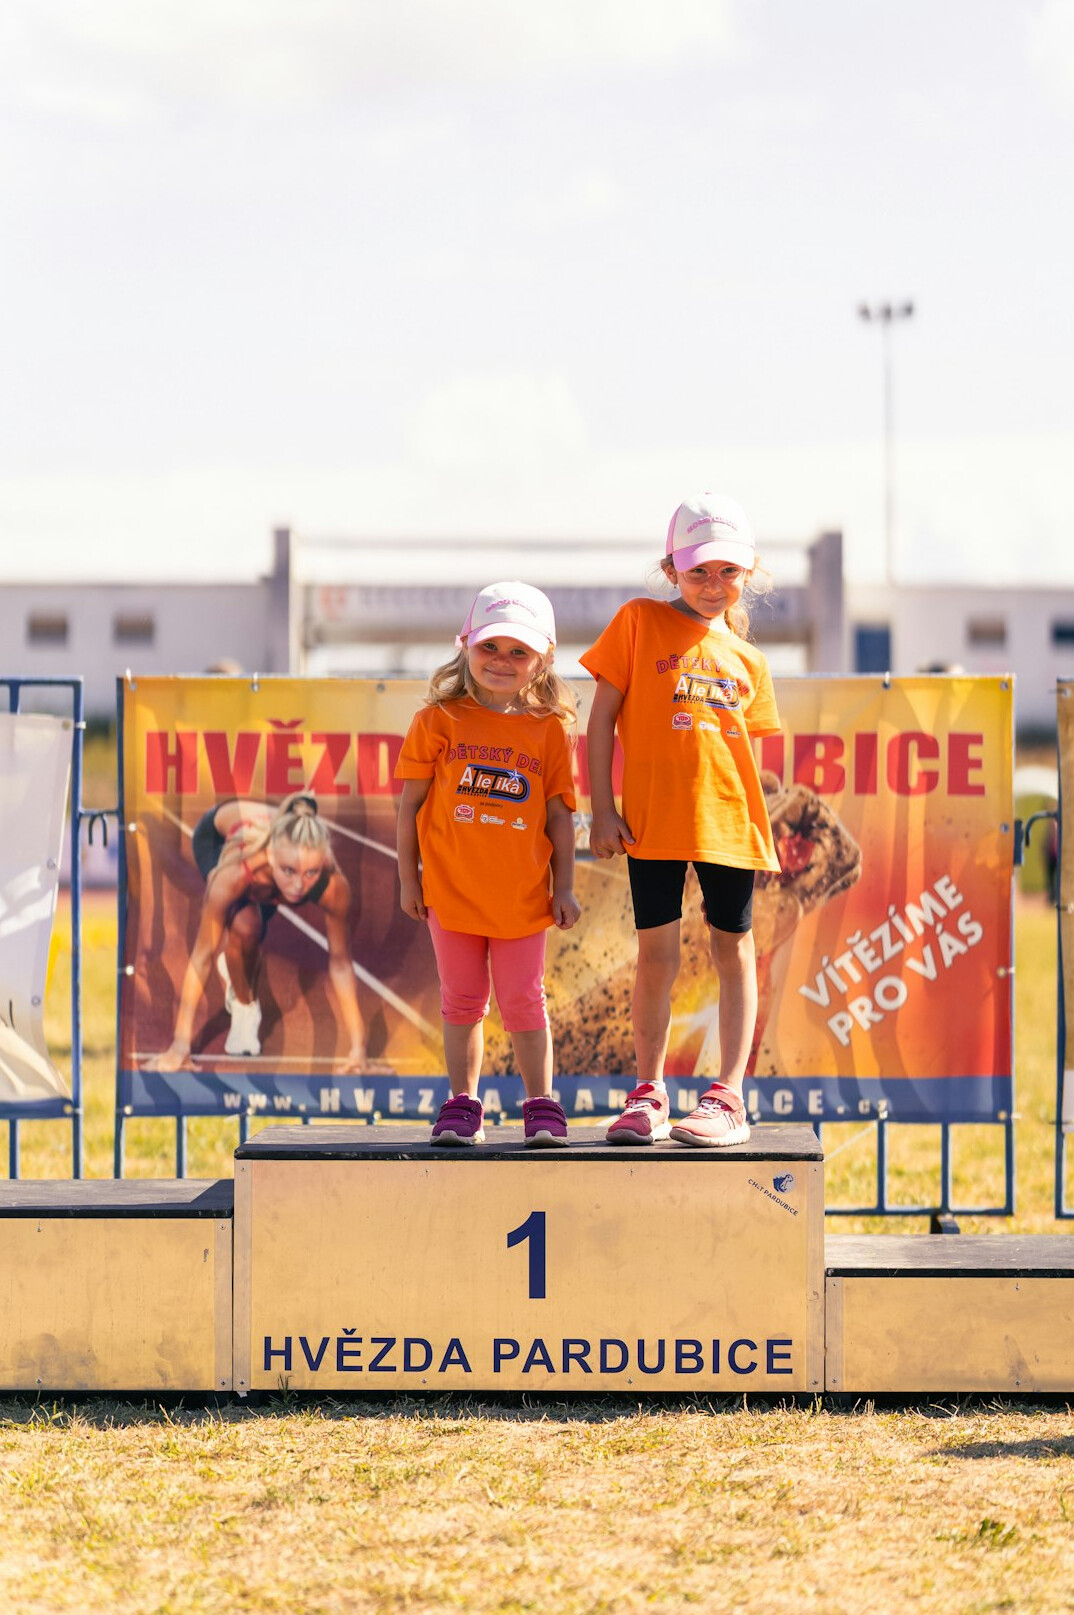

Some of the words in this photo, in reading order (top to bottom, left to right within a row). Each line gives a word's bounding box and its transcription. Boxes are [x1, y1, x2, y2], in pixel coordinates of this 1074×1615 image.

[146, 720, 406, 796] HVĚZD
[516, 754, 543, 776] DE
[798, 874, 964, 1008] VÍTĚZÍME
[827, 975, 908, 1047] PRO
[905, 911, 984, 981] VÁS
[763, 1189, 799, 1217] PARDUBICE
[507, 1212, 547, 1300] 1
[264, 1329, 472, 1374] HVĚZDA
[494, 1338, 794, 1376] PARDUBICE
